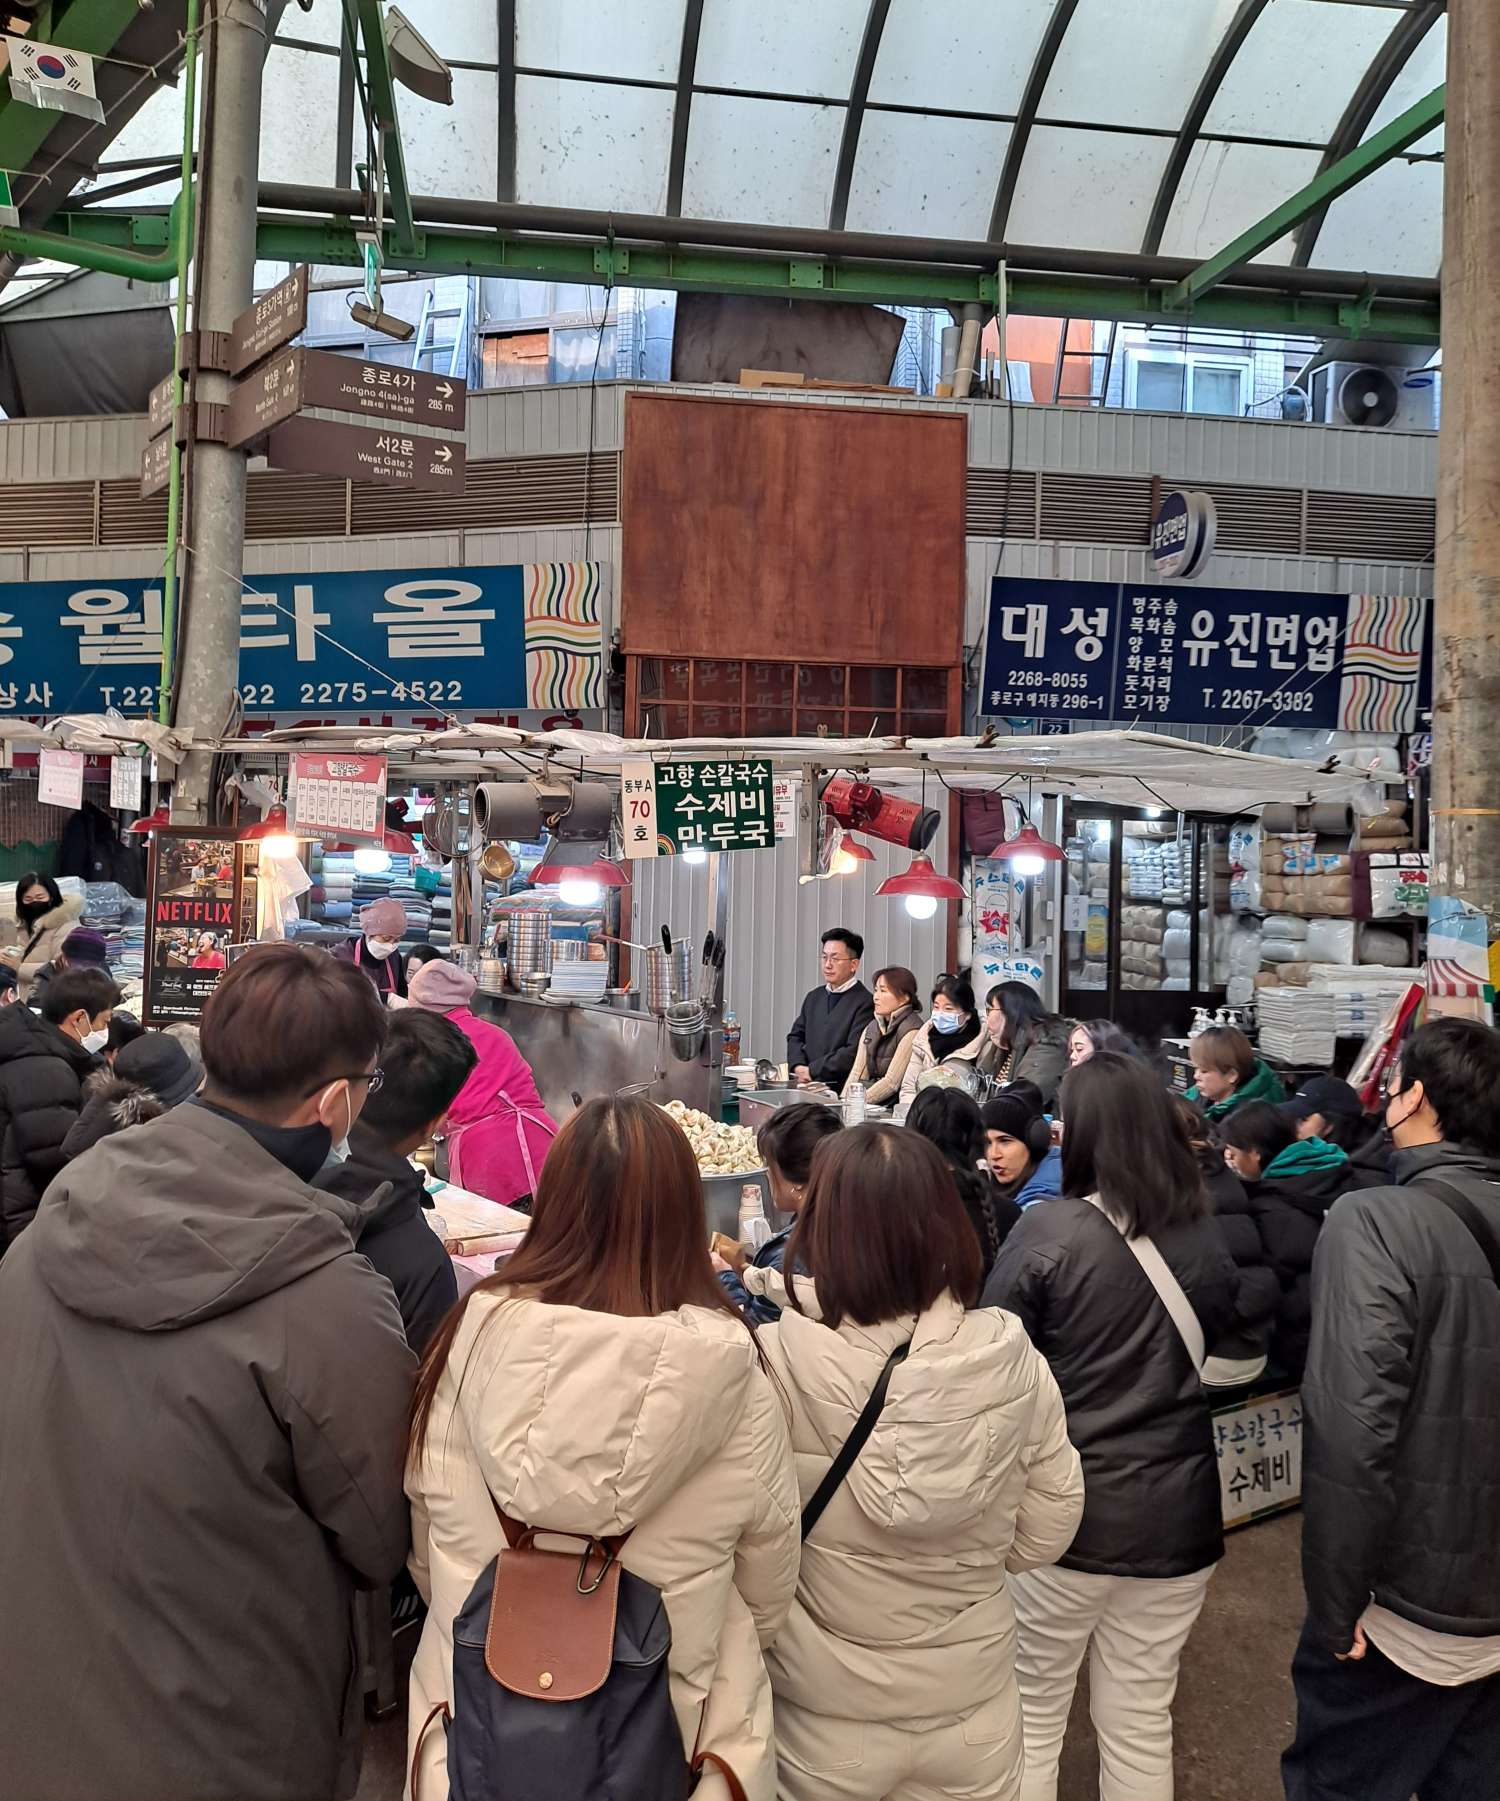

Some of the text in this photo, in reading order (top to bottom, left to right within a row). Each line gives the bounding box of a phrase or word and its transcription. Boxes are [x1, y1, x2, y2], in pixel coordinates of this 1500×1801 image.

[362, 366, 417, 391] 종로4가
[340, 383, 377, 397] Jongno
[427, 398, 443, 410] 285
[375, 436, 415, 456] 서2문
[357, 451, 382, 465] West
[383, 455, 406, 468] Gate
[407, 460, 414, 469] 2
[1132, 597, 1179, 616] 명주솜
[1129, 617, 1177, 636] 목화솜
[1182, 609, 1339, 673] 유진면업
[1126, 656, 1173, 674] 화문석
[1008, 670, 1088, 689] 2268-8055
[300, 680, 463, 704] 2275-4522
[990, 690, 1025, 707] 종로구
[1062, 694, 1104, 709] 296-1
[1221, 689, 1314, 712] 2267-3382
[1122, 694, 1170, 712] 모기장
[1048, 724, 1062, 735] 22
[658, 763, 768, 788] 고향 손칼국수
[630, 800, 650, 819] 70
[674, 789, 766, 821] 수제비
[633, 825, 649, 842] 호
[677, 820, 769, 851] 만두국
[157, 901, 232, 924] NETFLIX
[1229, 1450, 1291, 1503] 수제비
